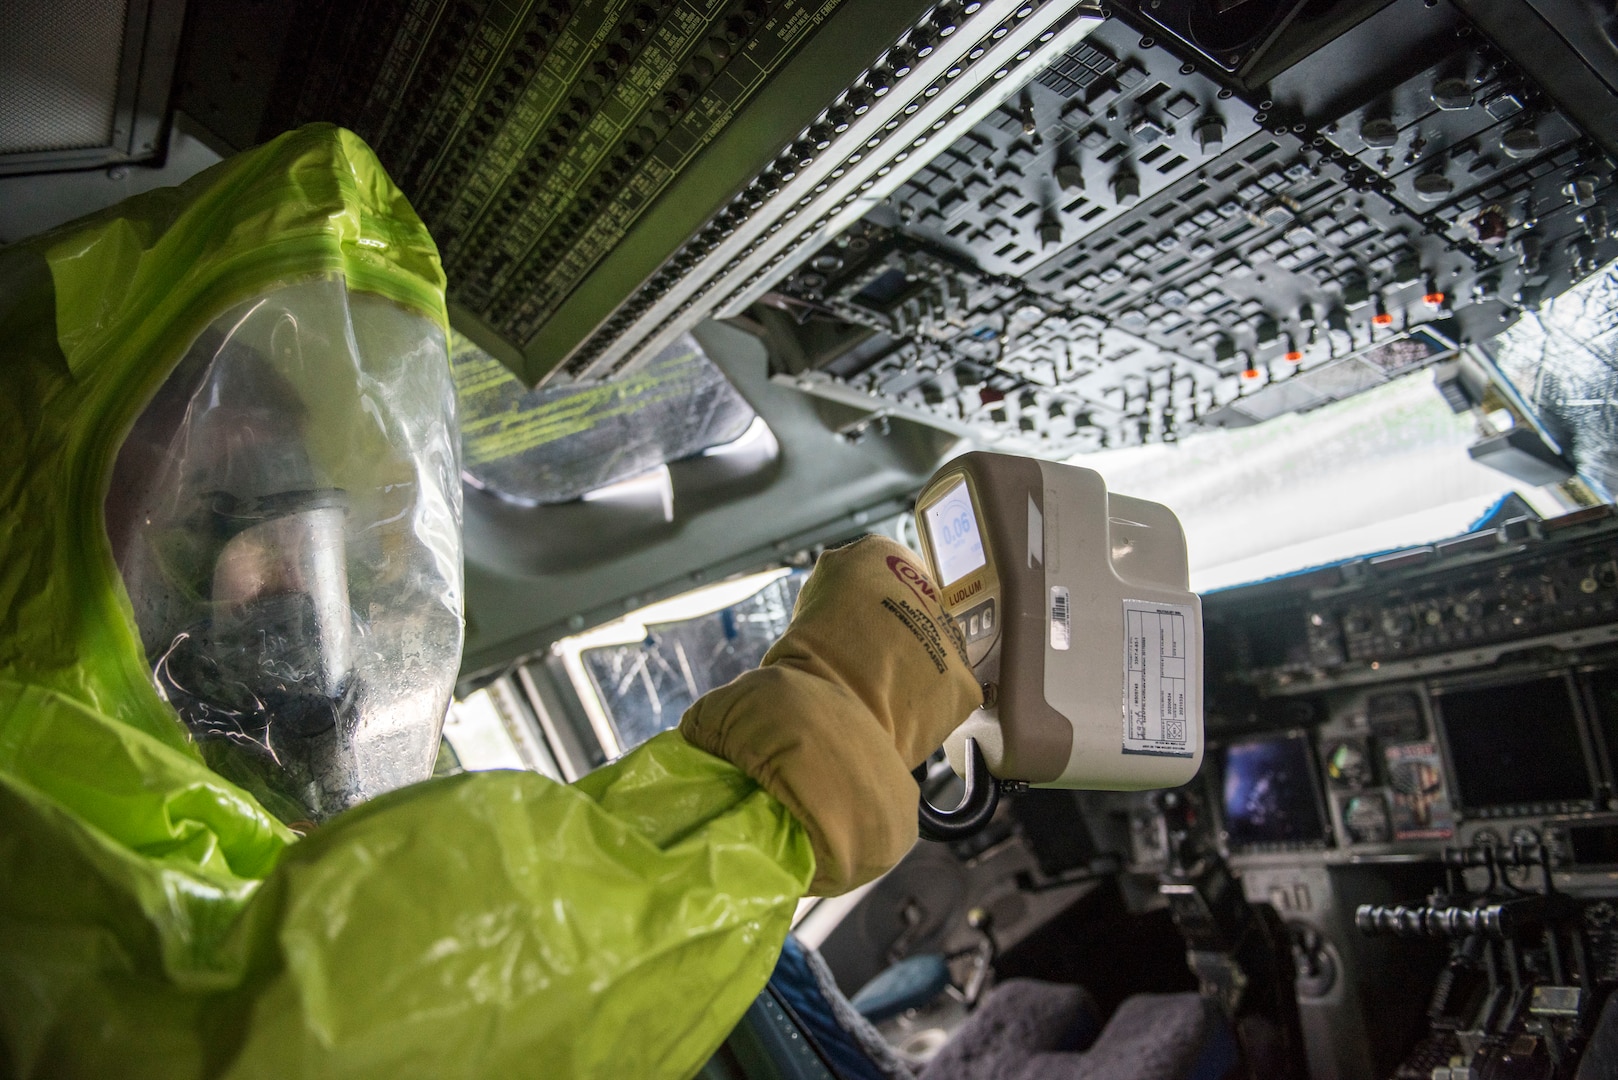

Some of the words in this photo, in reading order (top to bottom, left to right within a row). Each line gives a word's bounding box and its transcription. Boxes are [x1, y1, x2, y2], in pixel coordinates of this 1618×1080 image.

[596, 10, 620, 41] EMERGENCY
[776, 26, 788, 38] FUEL
[812, 13, 824, 24] DC
[747, 40, 757, 50] ENG
[647, 87, 656, 97] AC
[653, 61, 678, 90] EMERGENCY
[702, 134, 711, 143] AC
[708, 109, 735, 138] EMERGENCY
[942, 512, 971, 545] 0.06
[949, 579, 982, 607] LUDLUM
[880, 599, 925, 642] PERFORMANCE
[923, 641, 946, 674] PLASTICS
